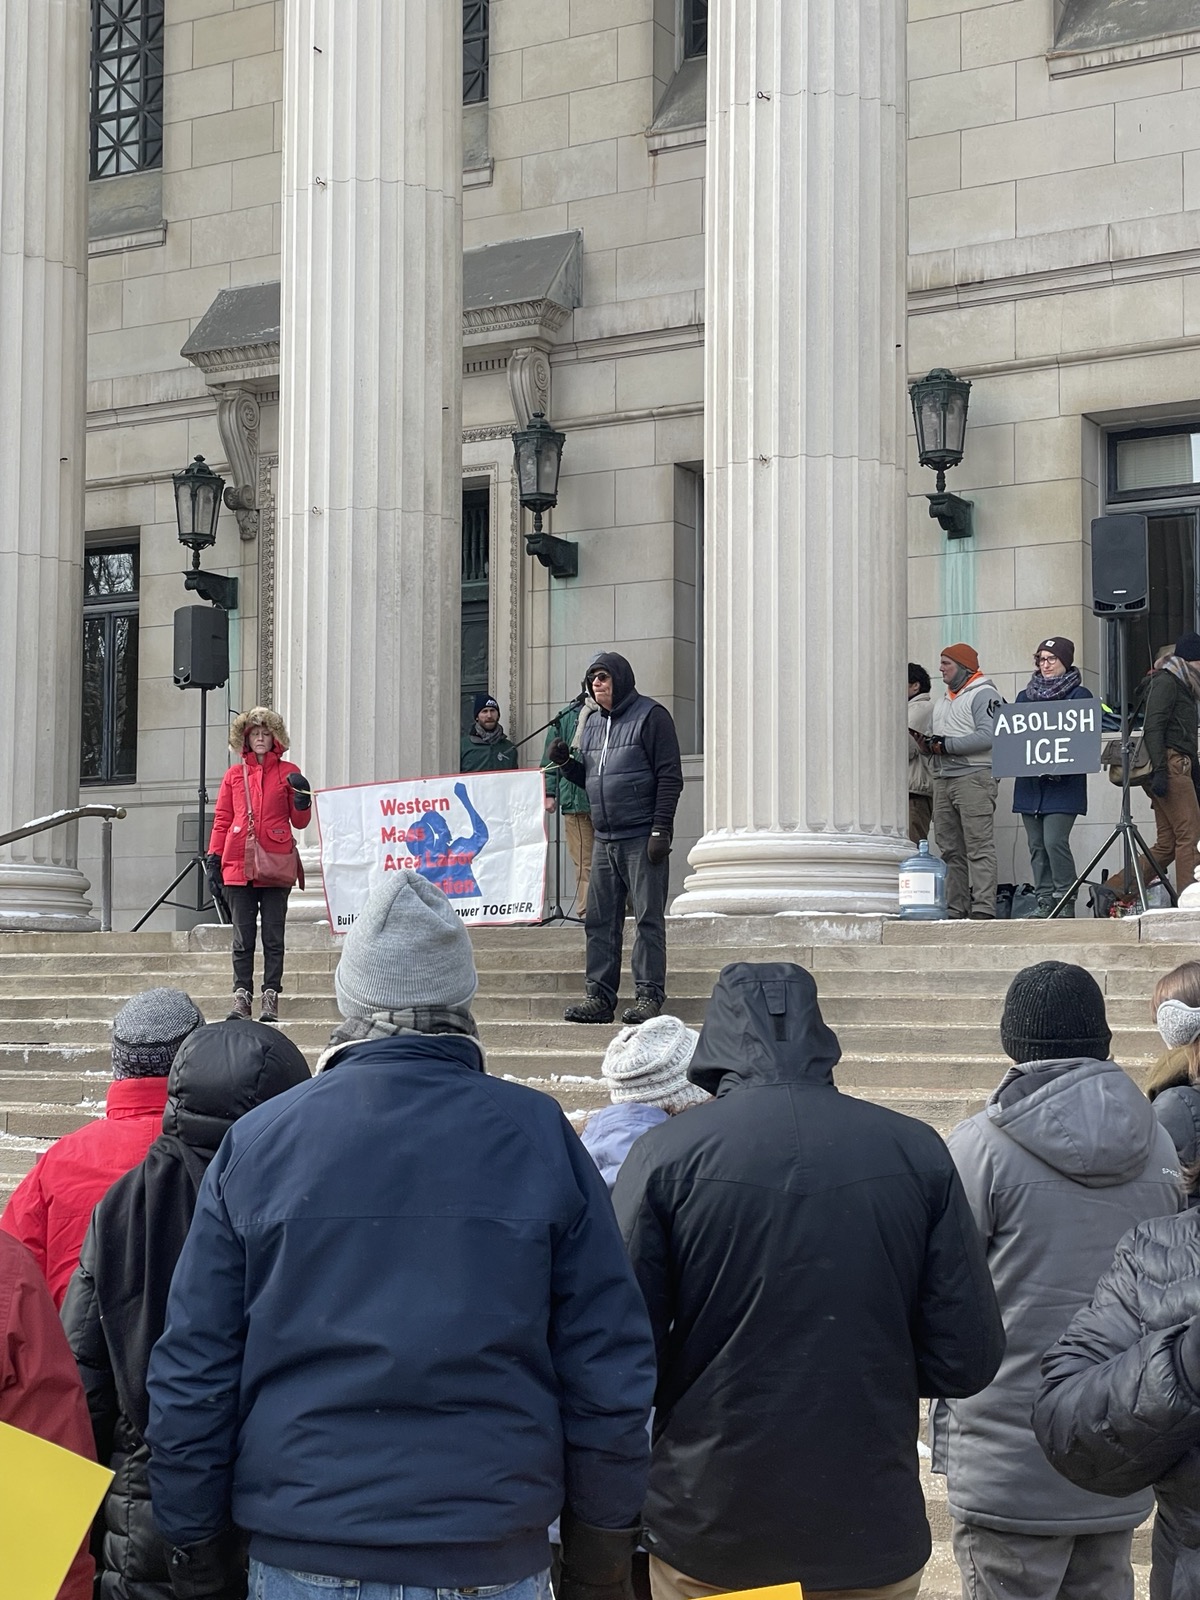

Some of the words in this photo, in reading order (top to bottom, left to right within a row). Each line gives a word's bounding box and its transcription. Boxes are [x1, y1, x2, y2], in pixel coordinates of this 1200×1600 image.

[994, 708, 1095, 737] ABOLISH
[1025, 737, 1075, 766] I.C.E.
[380, 797, 450, 817] Western
[381, 826, 426, 844] Mass
[383, 854, 422, 872] Area
[425, 848, 475, 868] Labor
[454, 906, 480, 917] ower
